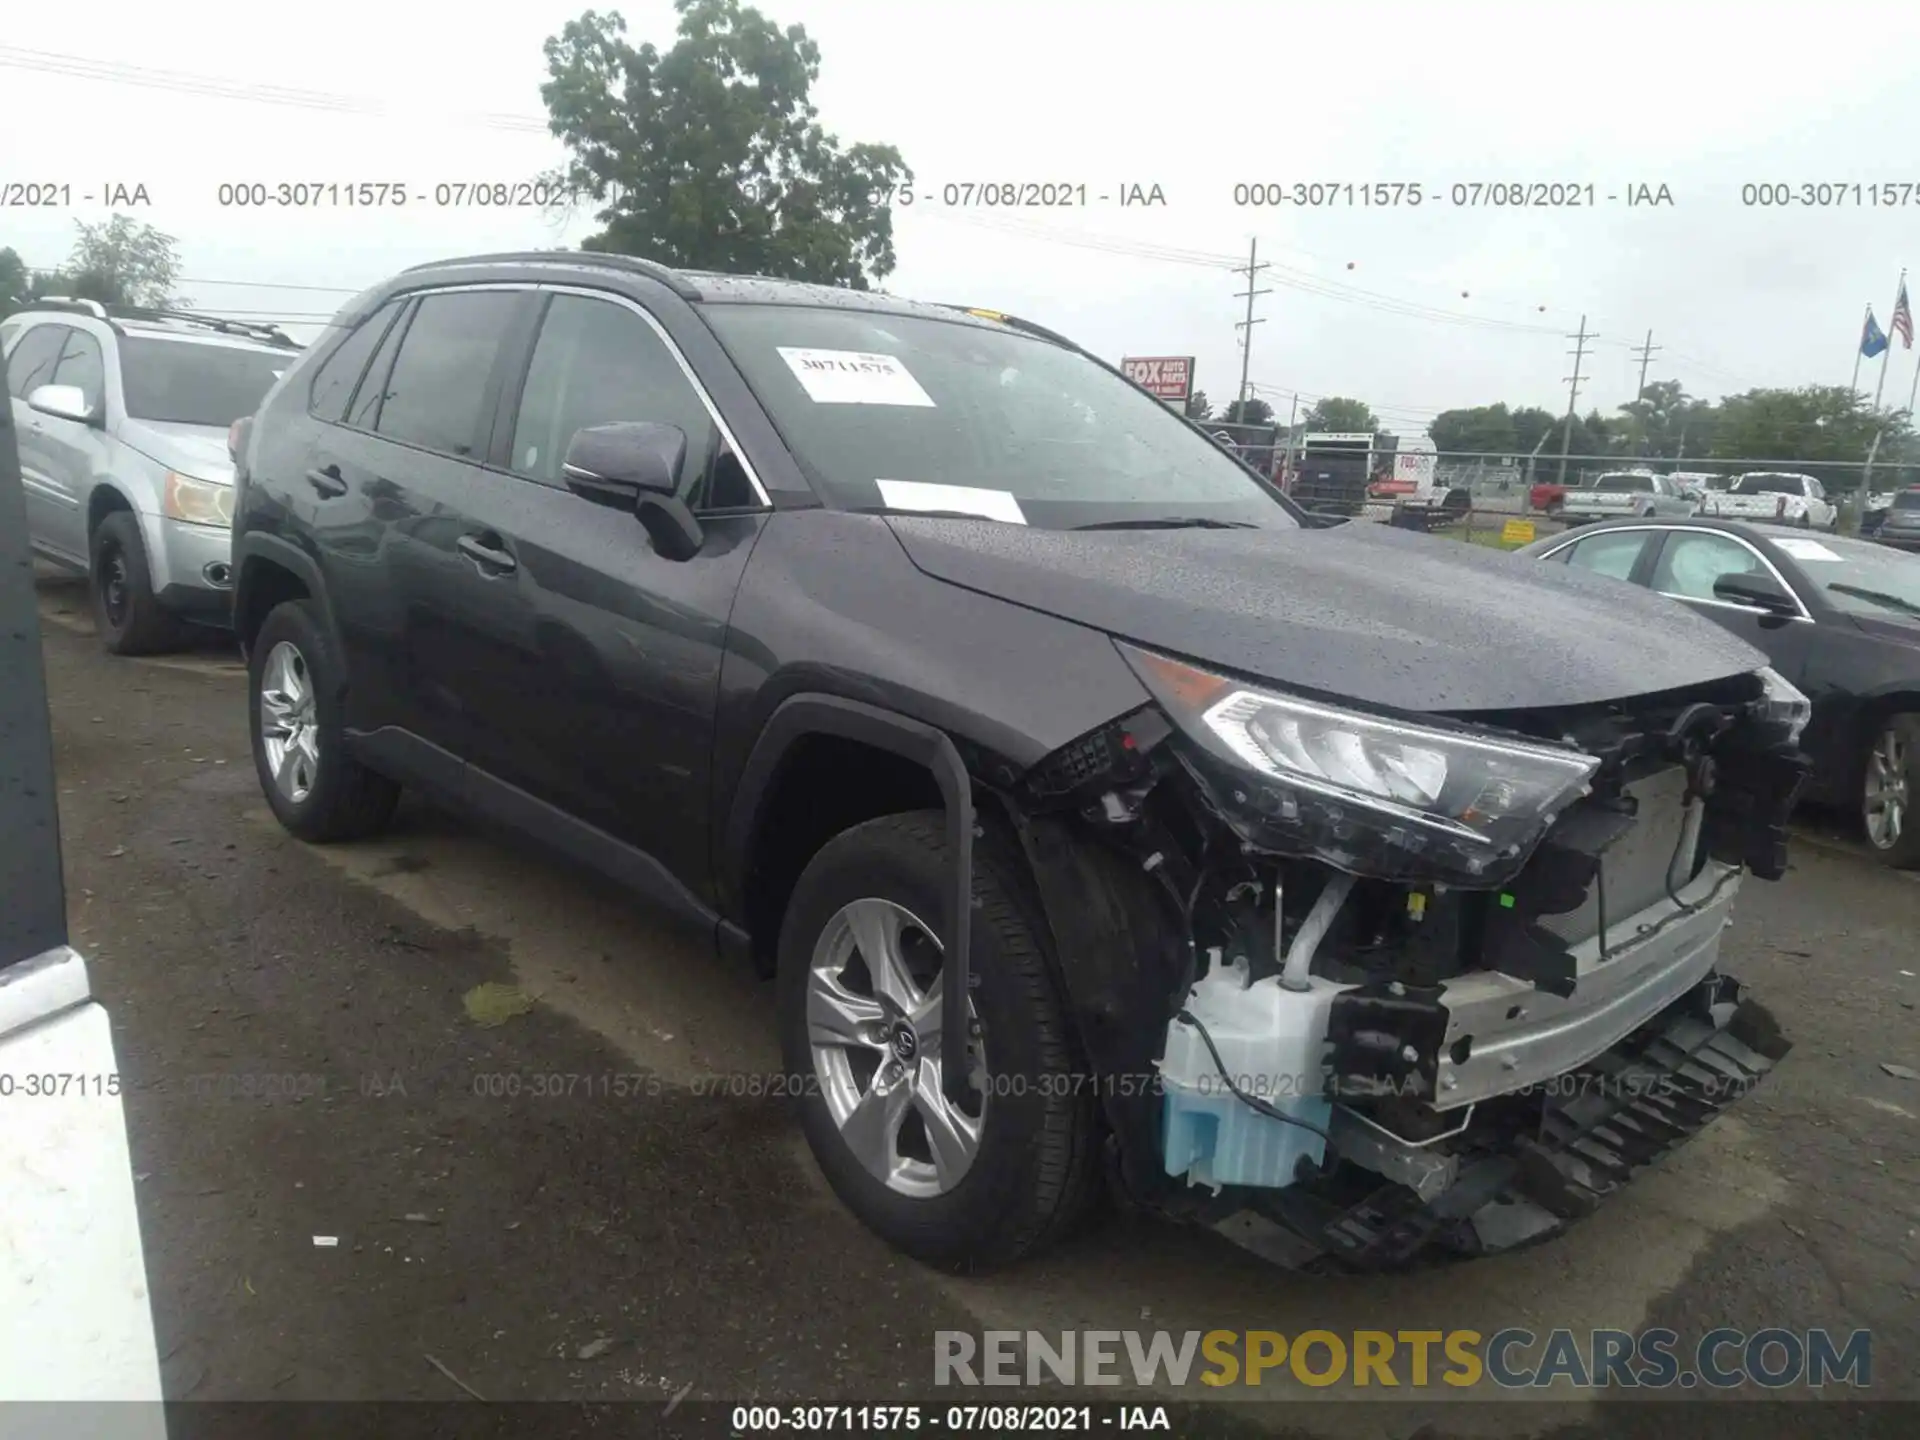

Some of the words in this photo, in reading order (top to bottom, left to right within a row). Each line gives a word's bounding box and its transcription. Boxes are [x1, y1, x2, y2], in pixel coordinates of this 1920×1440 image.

[801, 358, 896, 376] 30711575
[1125, 361, 1161, 384] FOX
[1162, 361, 1184, 372] AUTO
